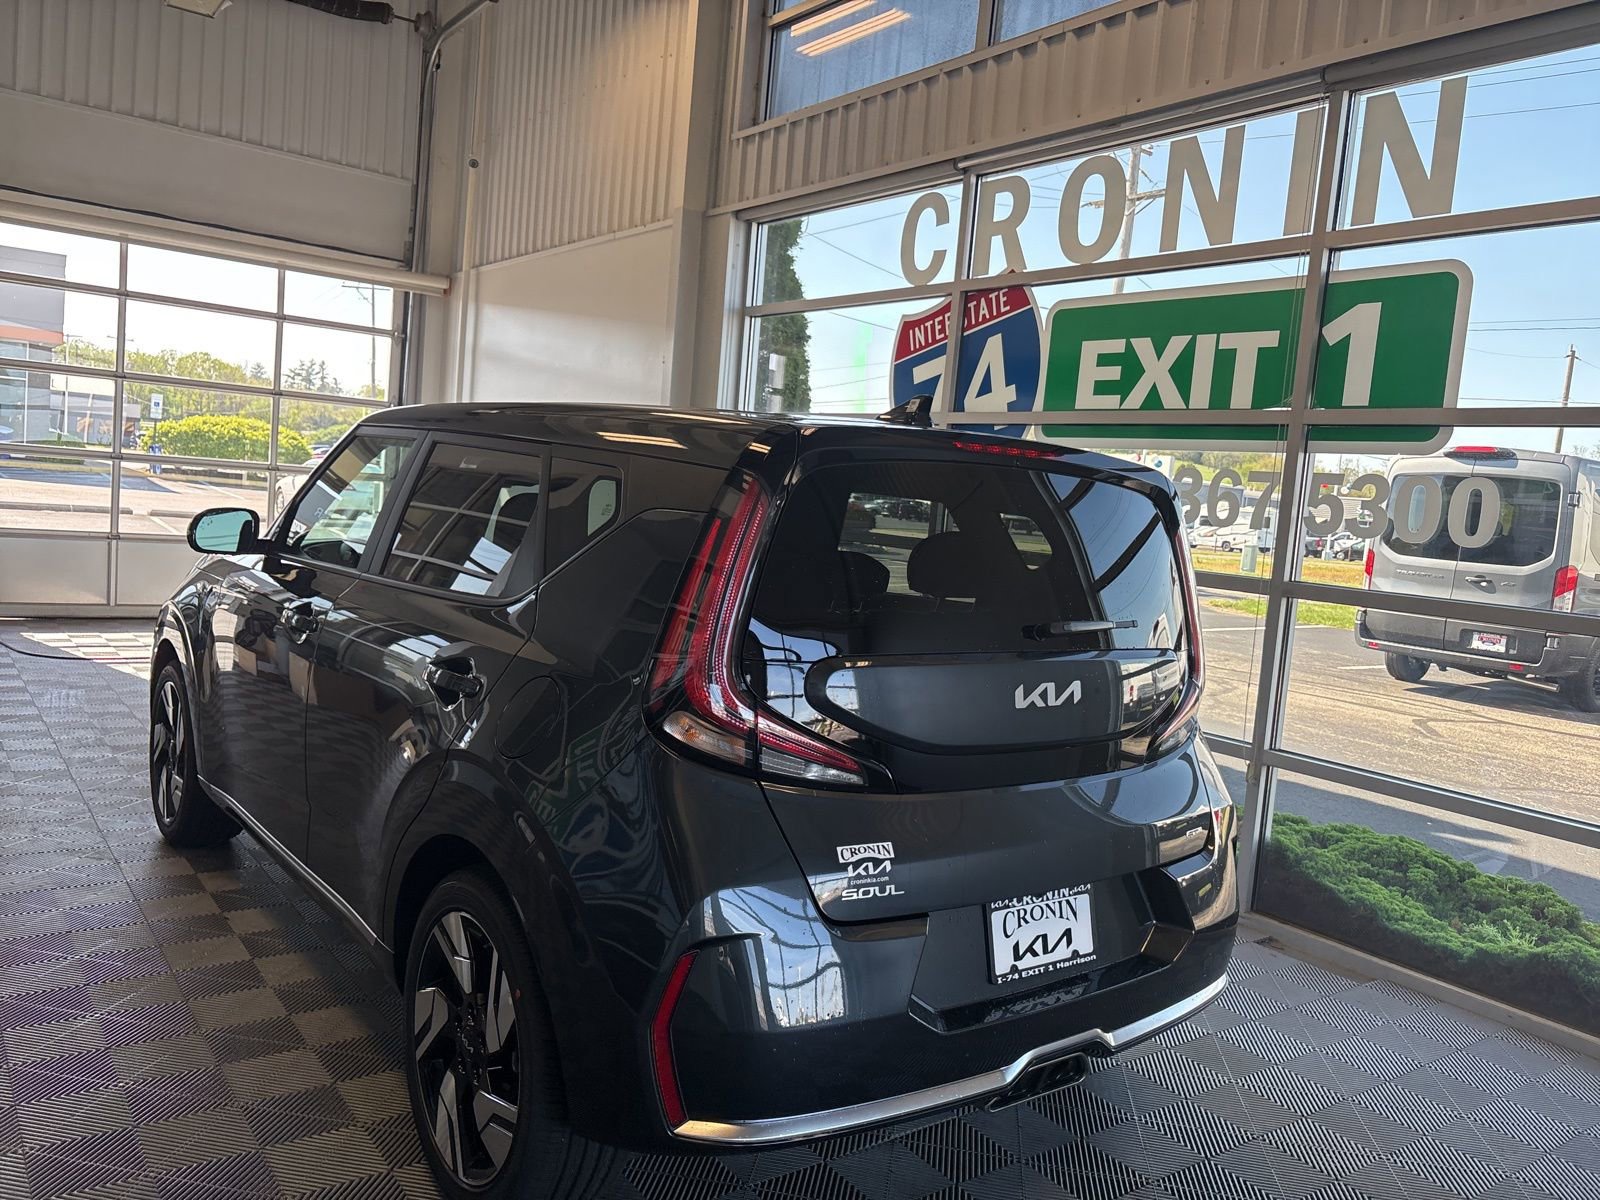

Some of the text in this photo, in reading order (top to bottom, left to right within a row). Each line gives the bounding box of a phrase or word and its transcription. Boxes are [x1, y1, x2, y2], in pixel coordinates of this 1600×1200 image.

[900, 75, 1468, 286] CRONIN
[909, 289, 1010, 351] INTETATE
[1075, 302, 1382, 410] EXIT 1
[912, 333, 1017, 431] 74
[1015, 680, 1082, 709] KIA
[840, 844, 893, 861] CRONIN
[847, 860, 892, 877] KIA
[841, 885, 905, 901] SOUL
[850, 876, 890, 885] croninkia.com
[1002, 897, 1079, 939] CRONIN
[1013, 927, 1073, 962] KIA
[997, 972, 1019, 984] I-74
[1021, 966, 1045, 978] EXIT
[1056, 954, 1097, 969] Harrison
